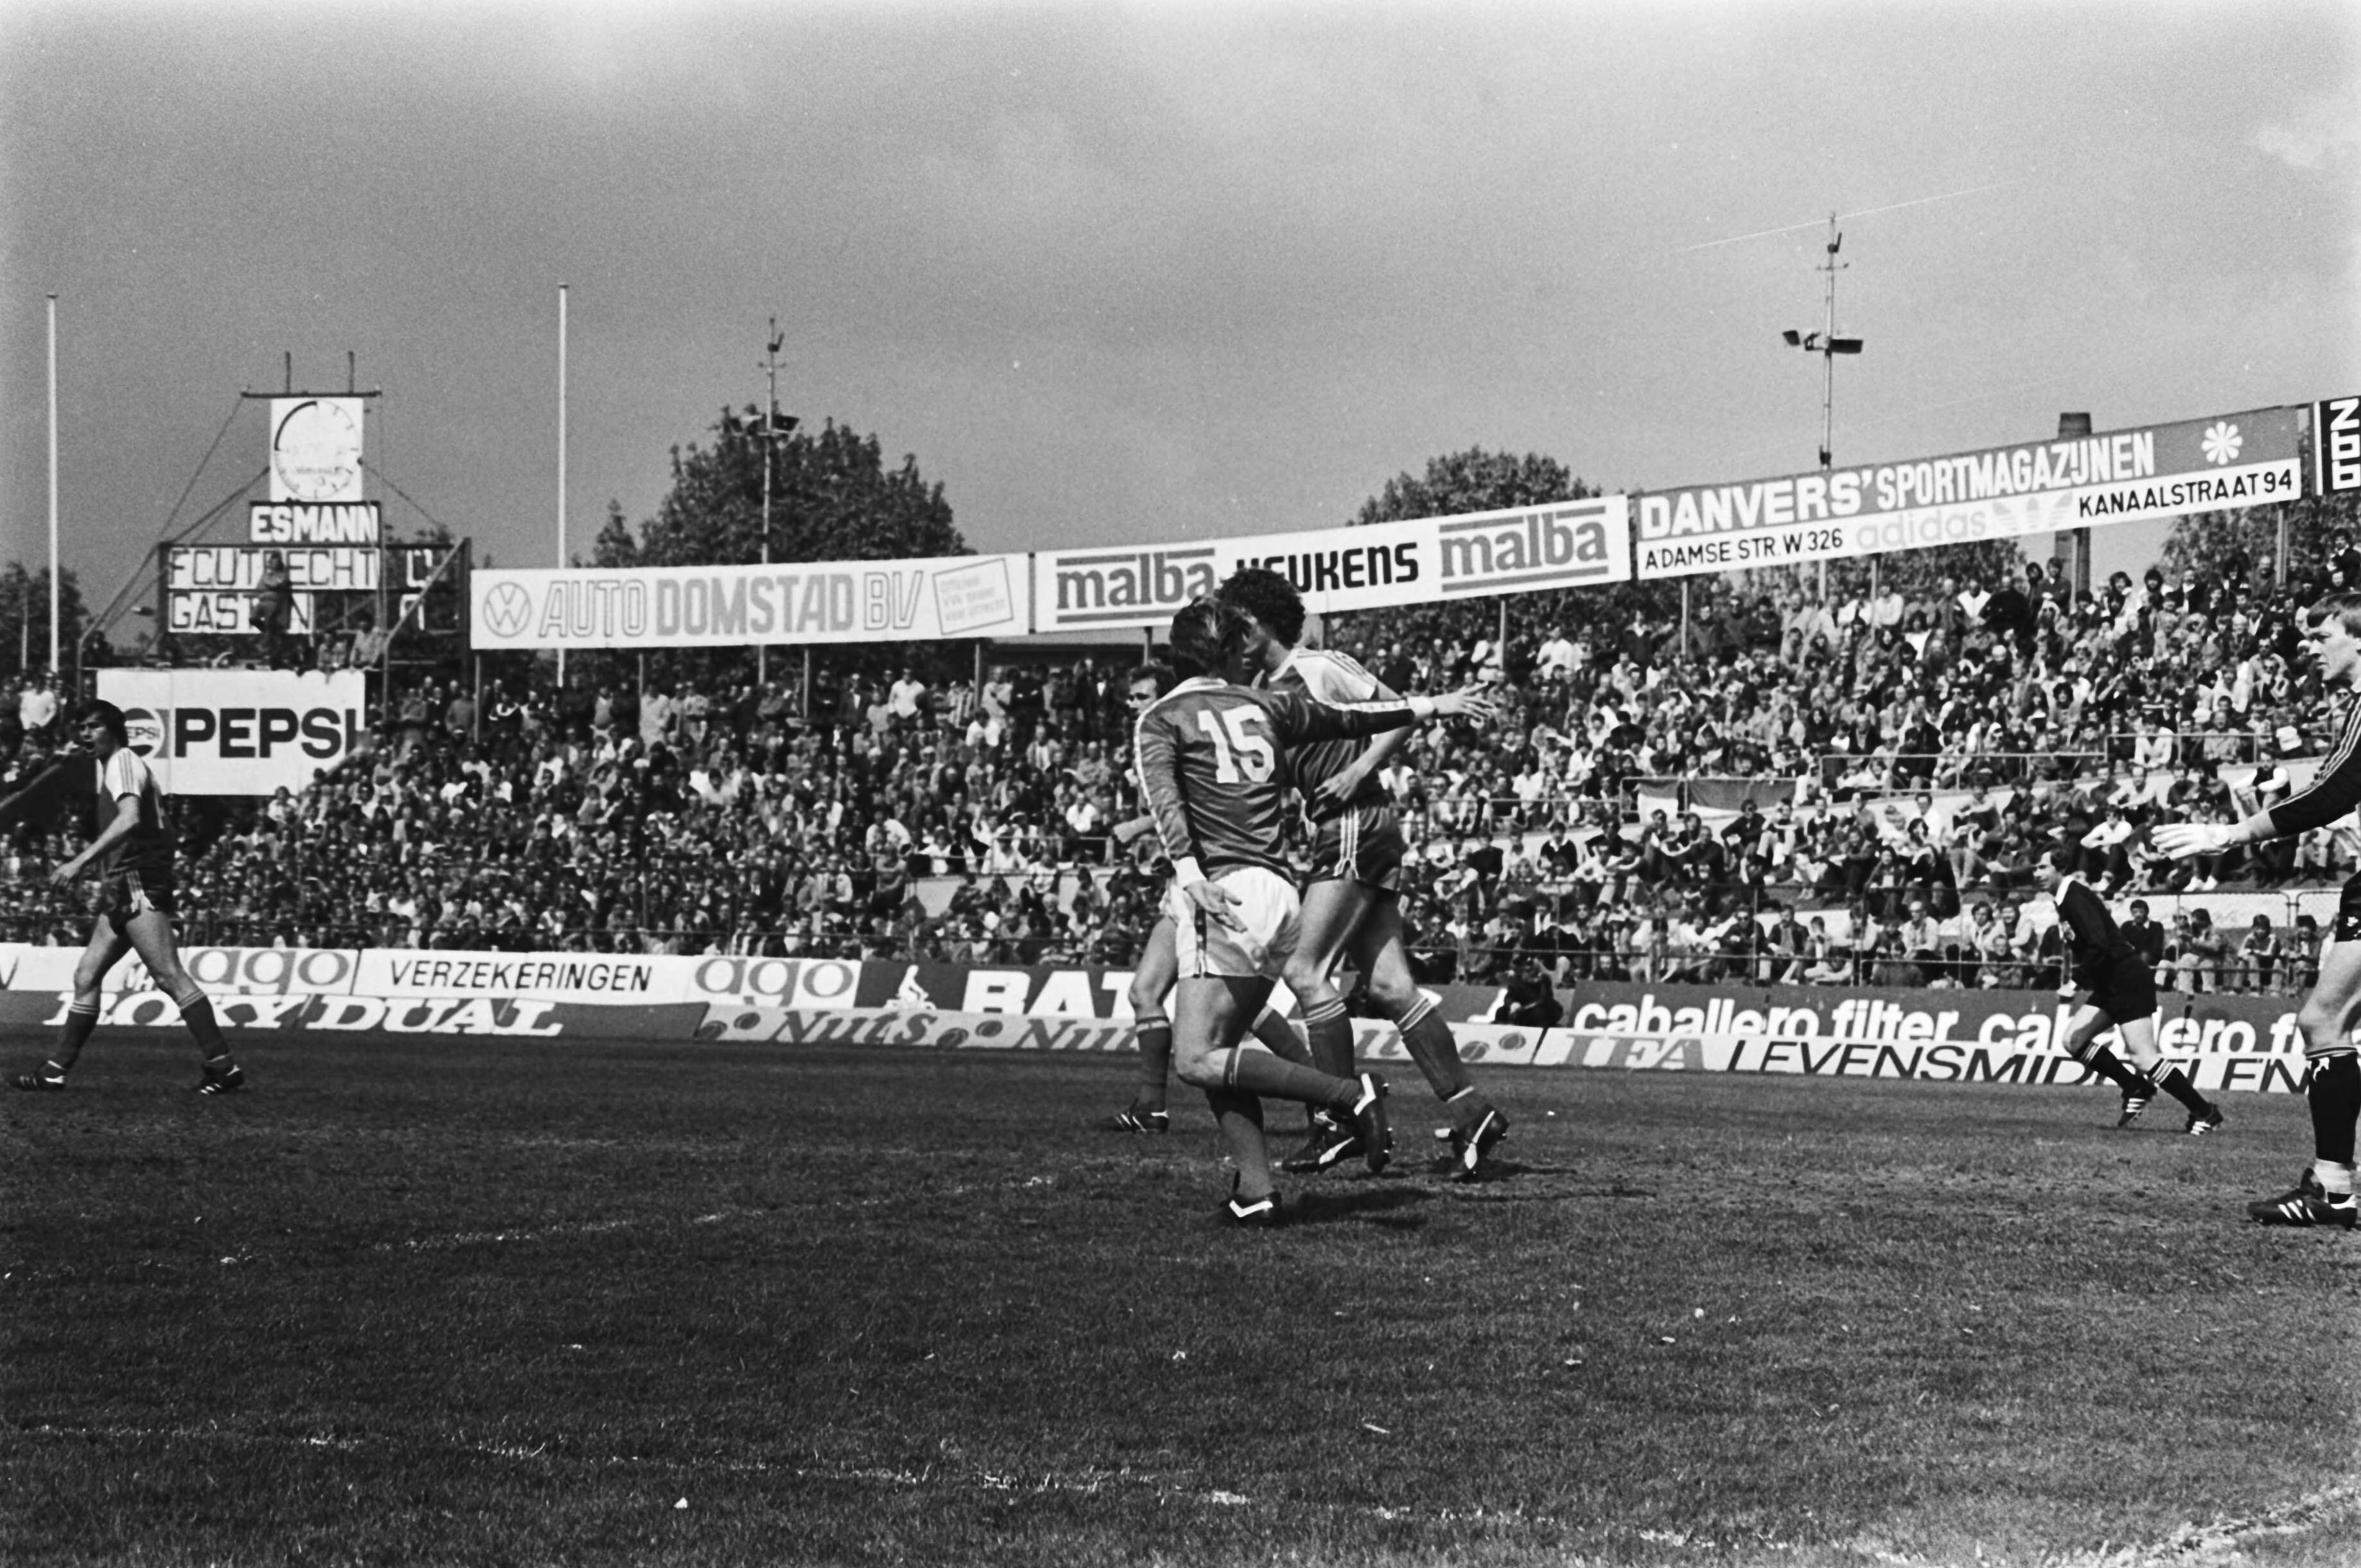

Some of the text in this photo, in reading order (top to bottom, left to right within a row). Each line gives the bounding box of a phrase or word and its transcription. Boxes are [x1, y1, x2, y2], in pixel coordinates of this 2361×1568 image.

[1640, 431, 2155, 539] DANVERS' SPORTMAGAZIJNEN
[2080, 469, 2292, 518] KANAALSTRAAT 94
[250, 505, 378, 542] ESMANN
[1439, 512, 1609, 577] malba
[1855, 510, 1987, 550] adidas
[1645, 541, 1731, 570] ADAMSE
[1782, 532, 1804, 555] W
[1807, 528, 1843, 550] 326
[538, 570, 924, 638] AUTO DOMSTAD BV
[1056, 553, 1215, 609] malba
[126, 726, 159, 739] EPSI
[175, 708, 356, 759] PEPSI
[1198, 704, 1276, 784] 15
[391, 959, 652, 992] VERZEKERINGEN
[305, 995, 563, 1036] DUAL
[1574, 994, 1819, 1038] caballero
[1831, 999, 1959, 1043] filter
